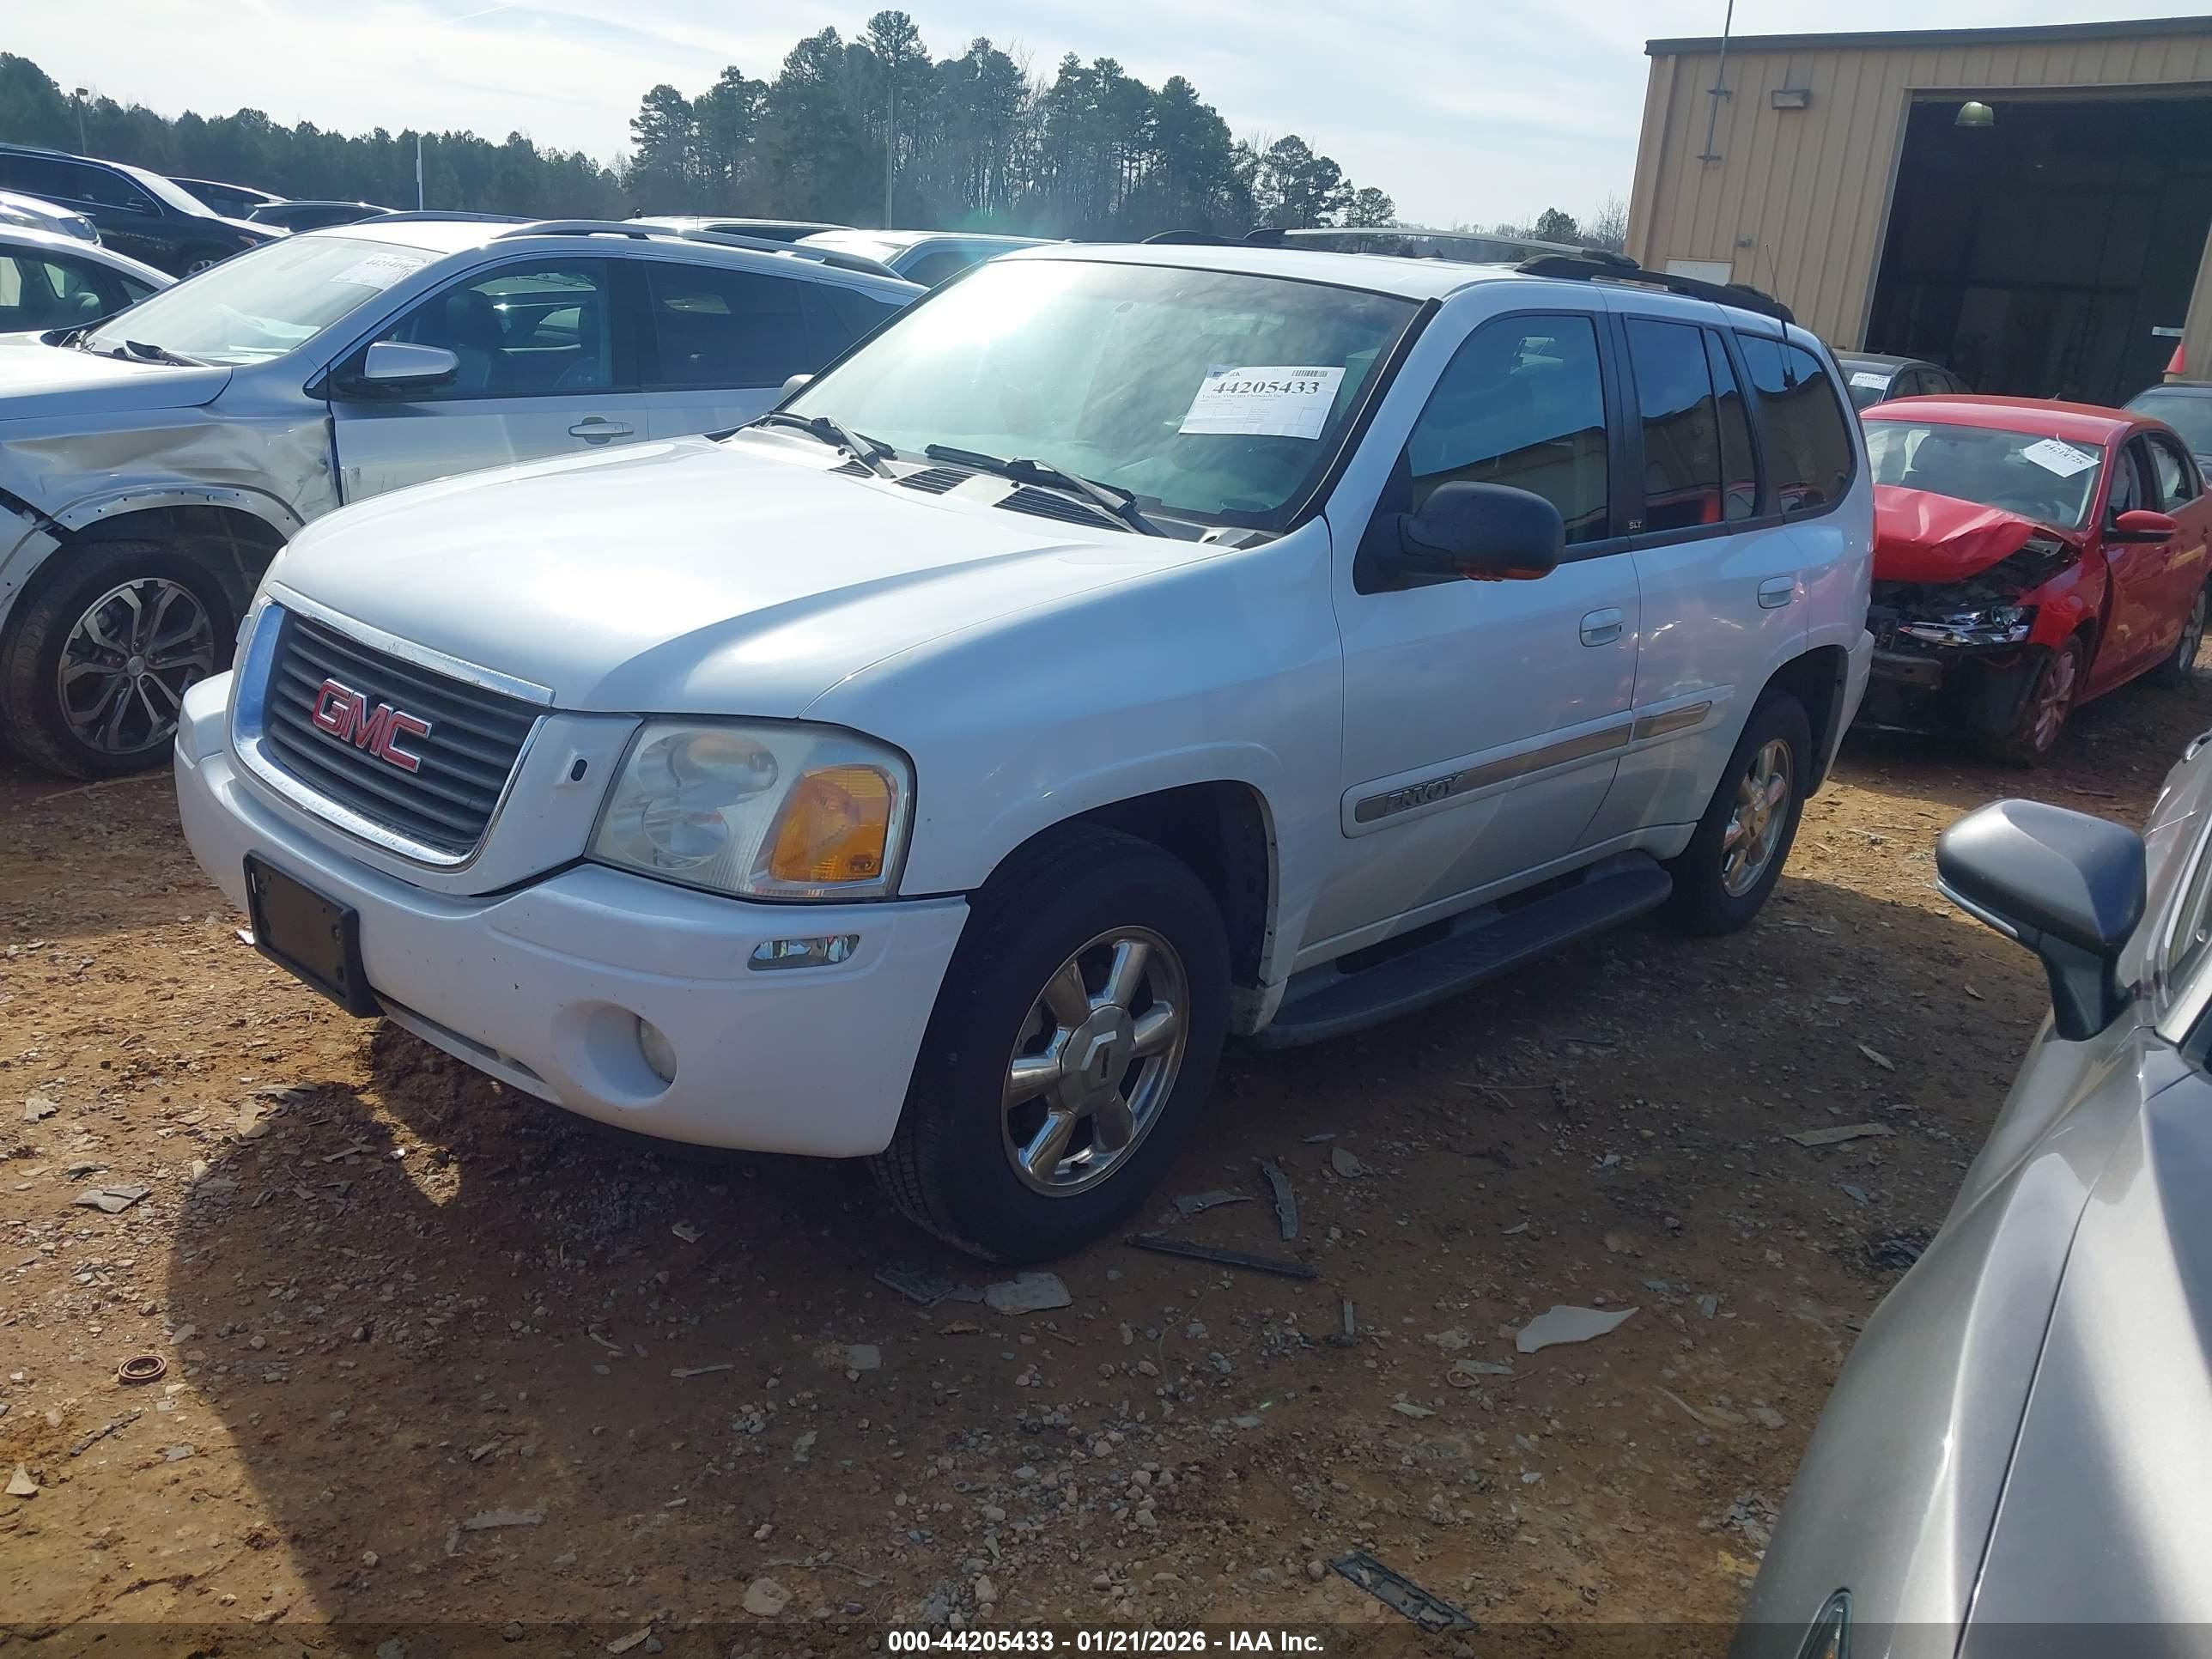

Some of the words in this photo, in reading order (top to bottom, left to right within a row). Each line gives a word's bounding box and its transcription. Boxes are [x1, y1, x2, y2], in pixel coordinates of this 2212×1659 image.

[1212, 381, 1320, 395] 44205433
[1628, 521, 1642, 530] SLT
[313, 678, 432, 773] GMC
[1385, 775, 1463, 812] ENVOY
